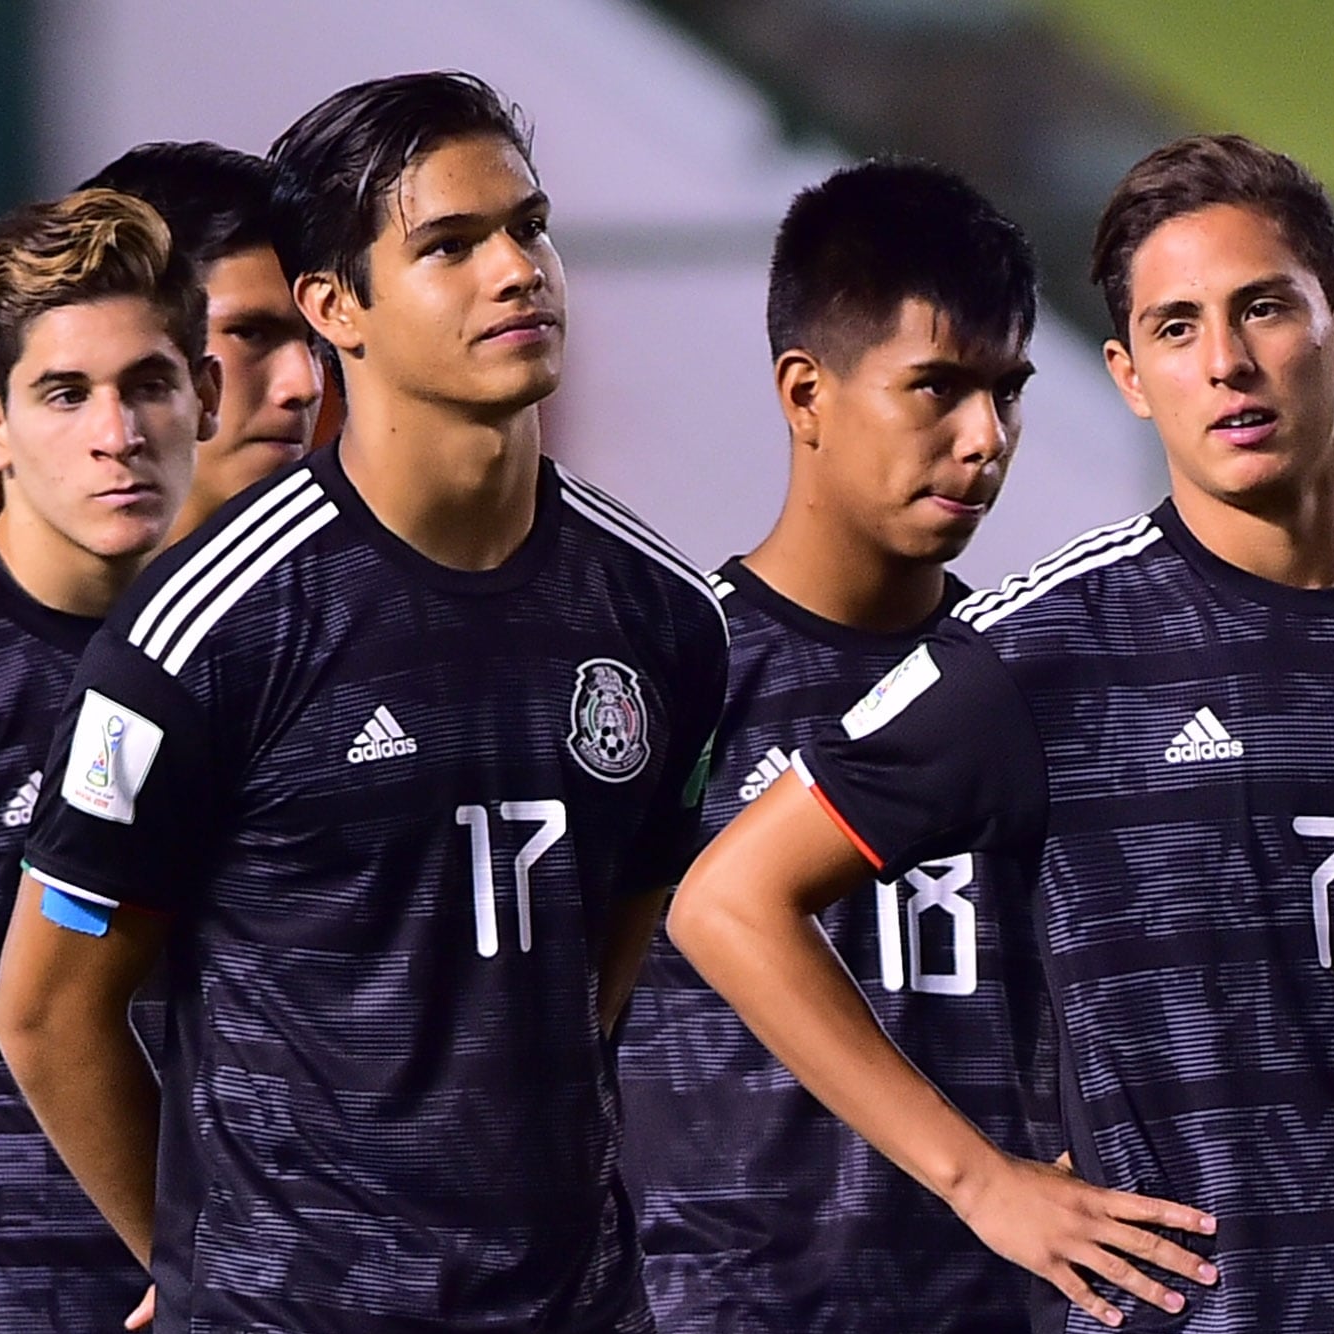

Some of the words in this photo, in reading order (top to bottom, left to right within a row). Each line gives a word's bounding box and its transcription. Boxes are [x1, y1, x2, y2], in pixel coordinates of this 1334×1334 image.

[347, 737, 417, 763] adidas
[1165, 739, 1244, 763] adidas
[456, 799, 567, 958] 17
[875, 852, 978, 995] 18
